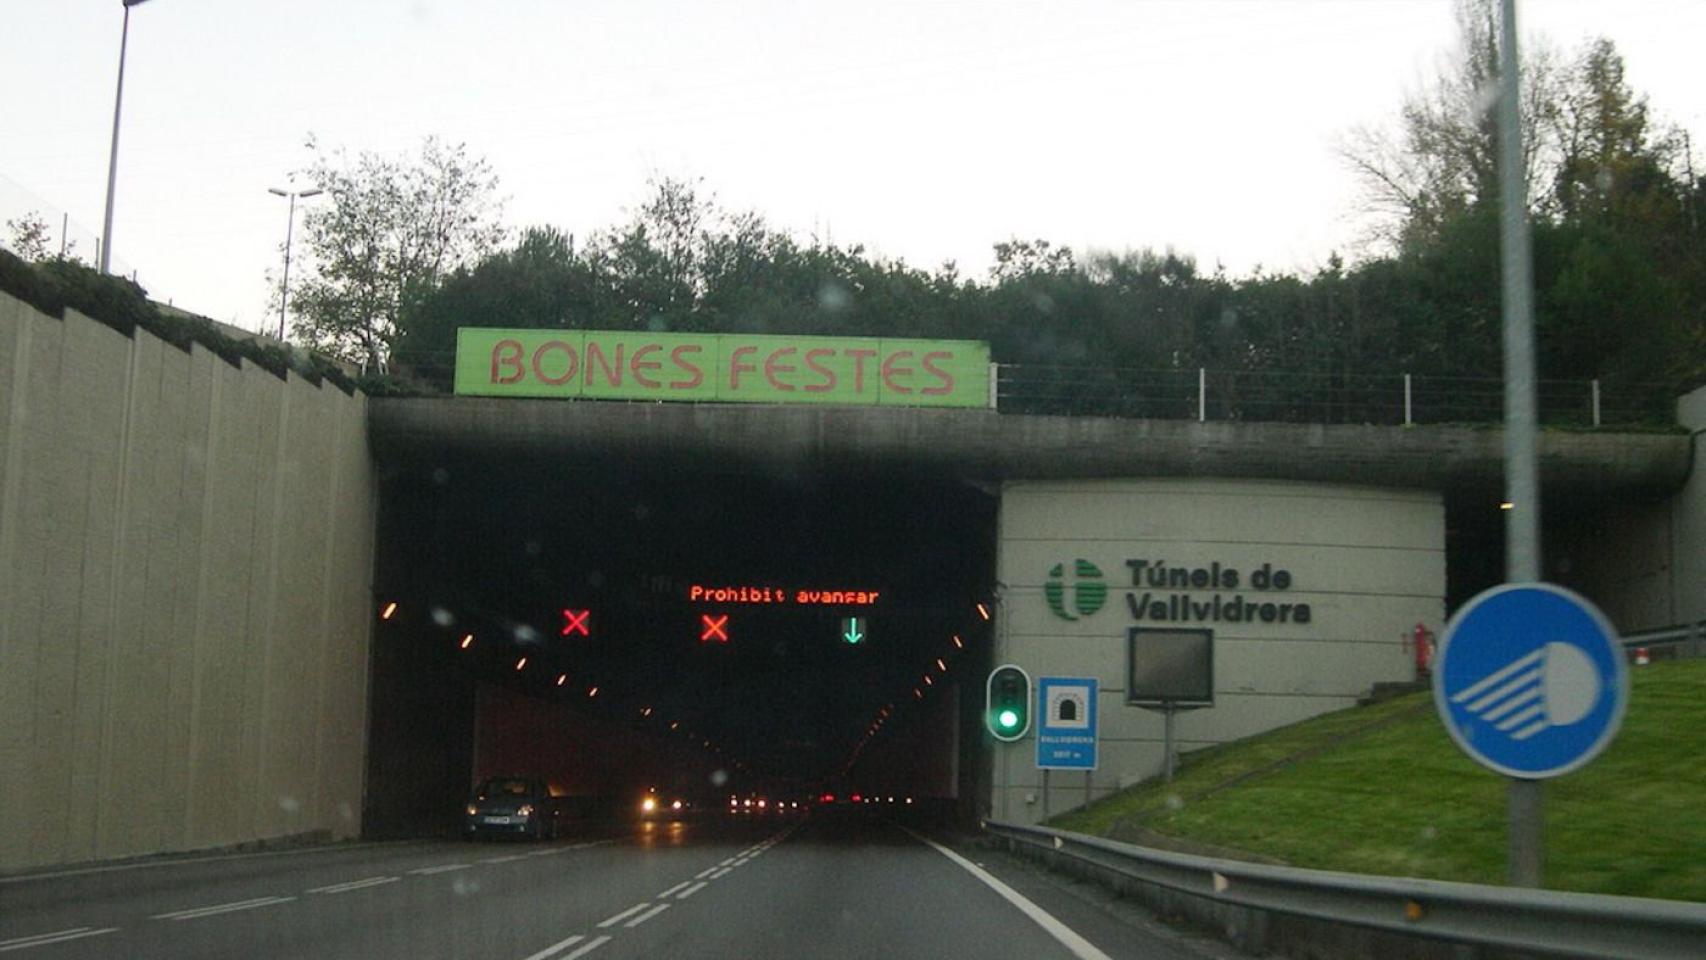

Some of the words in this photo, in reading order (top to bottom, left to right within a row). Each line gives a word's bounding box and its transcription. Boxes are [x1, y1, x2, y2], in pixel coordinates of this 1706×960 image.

[491, 339, 704, 390] BONES
[730, 346, 955, 396] FESTES
[1125, 559, 1240, 589] Túnels
[1251, 563, 1292, 590] de
[690, 585, 785, 603] Prohibit
[1125, 592, 1312, 624] Vallvidrera
